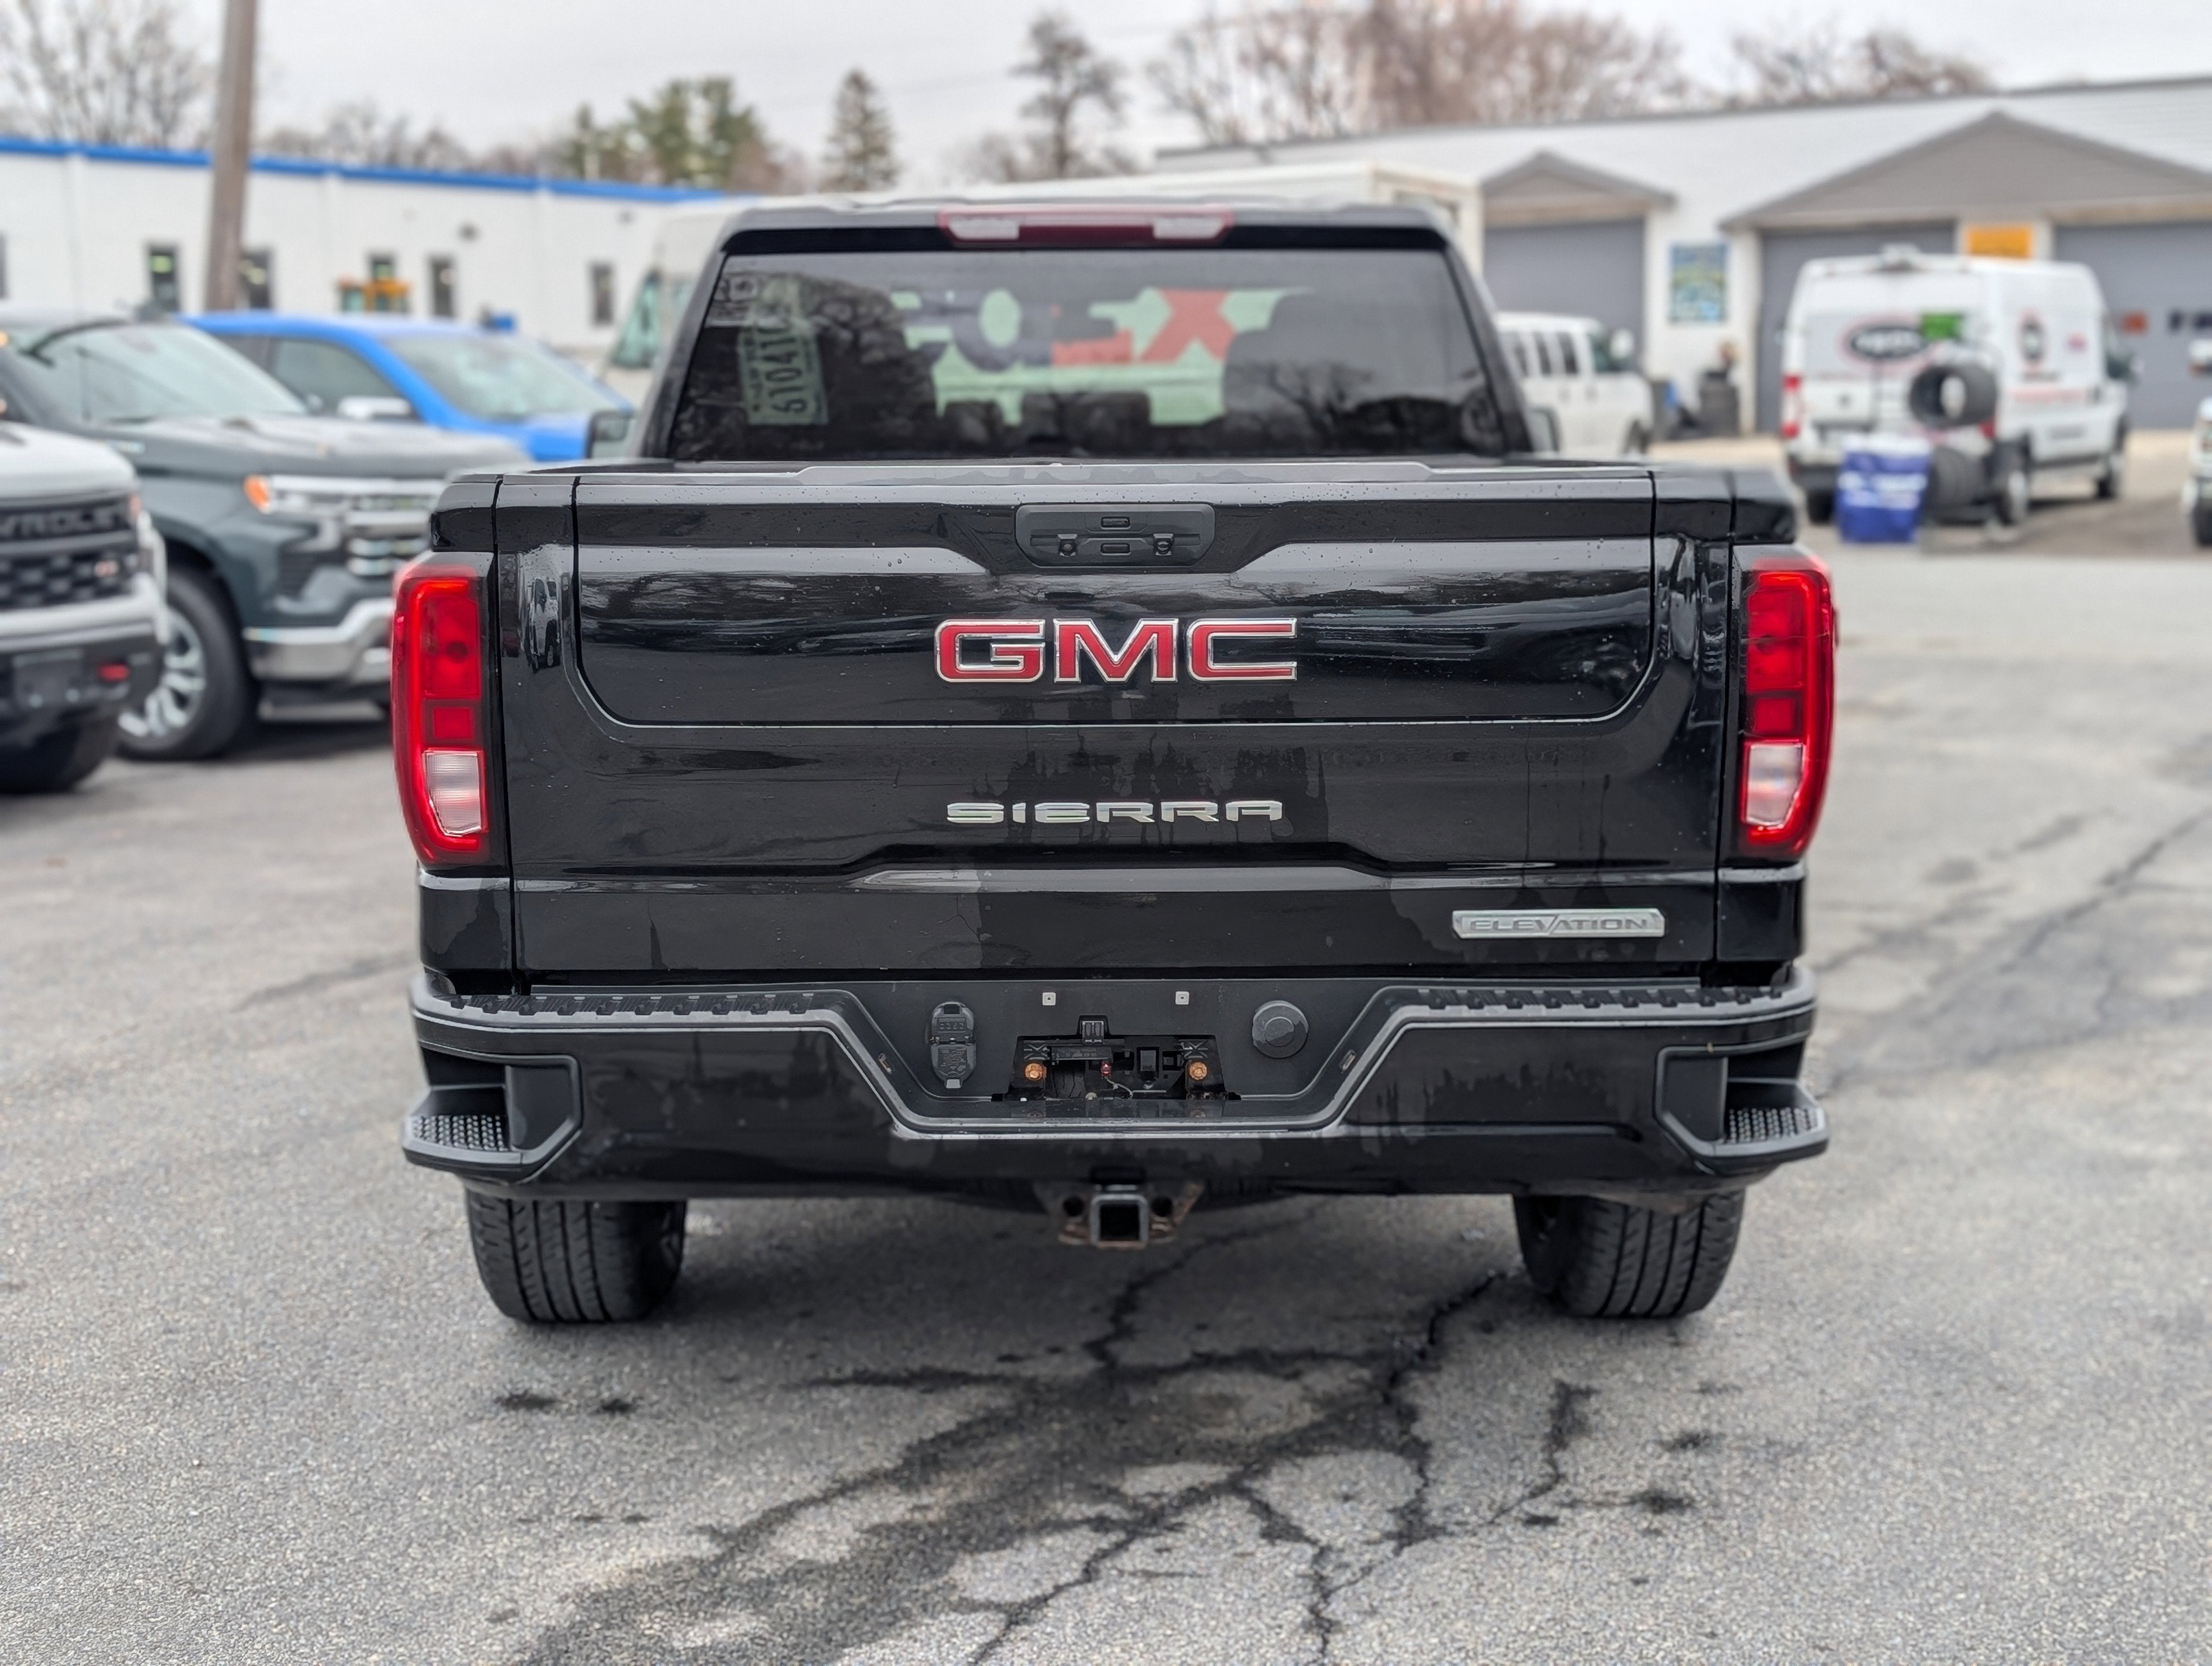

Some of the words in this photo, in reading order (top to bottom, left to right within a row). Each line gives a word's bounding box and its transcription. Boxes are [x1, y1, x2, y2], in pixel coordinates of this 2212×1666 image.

[935, 619, 1297, 682] GMC
[947, 800, 1282, 823] SIERRA
[1470, 919, 1648, 931] ELEVATION
